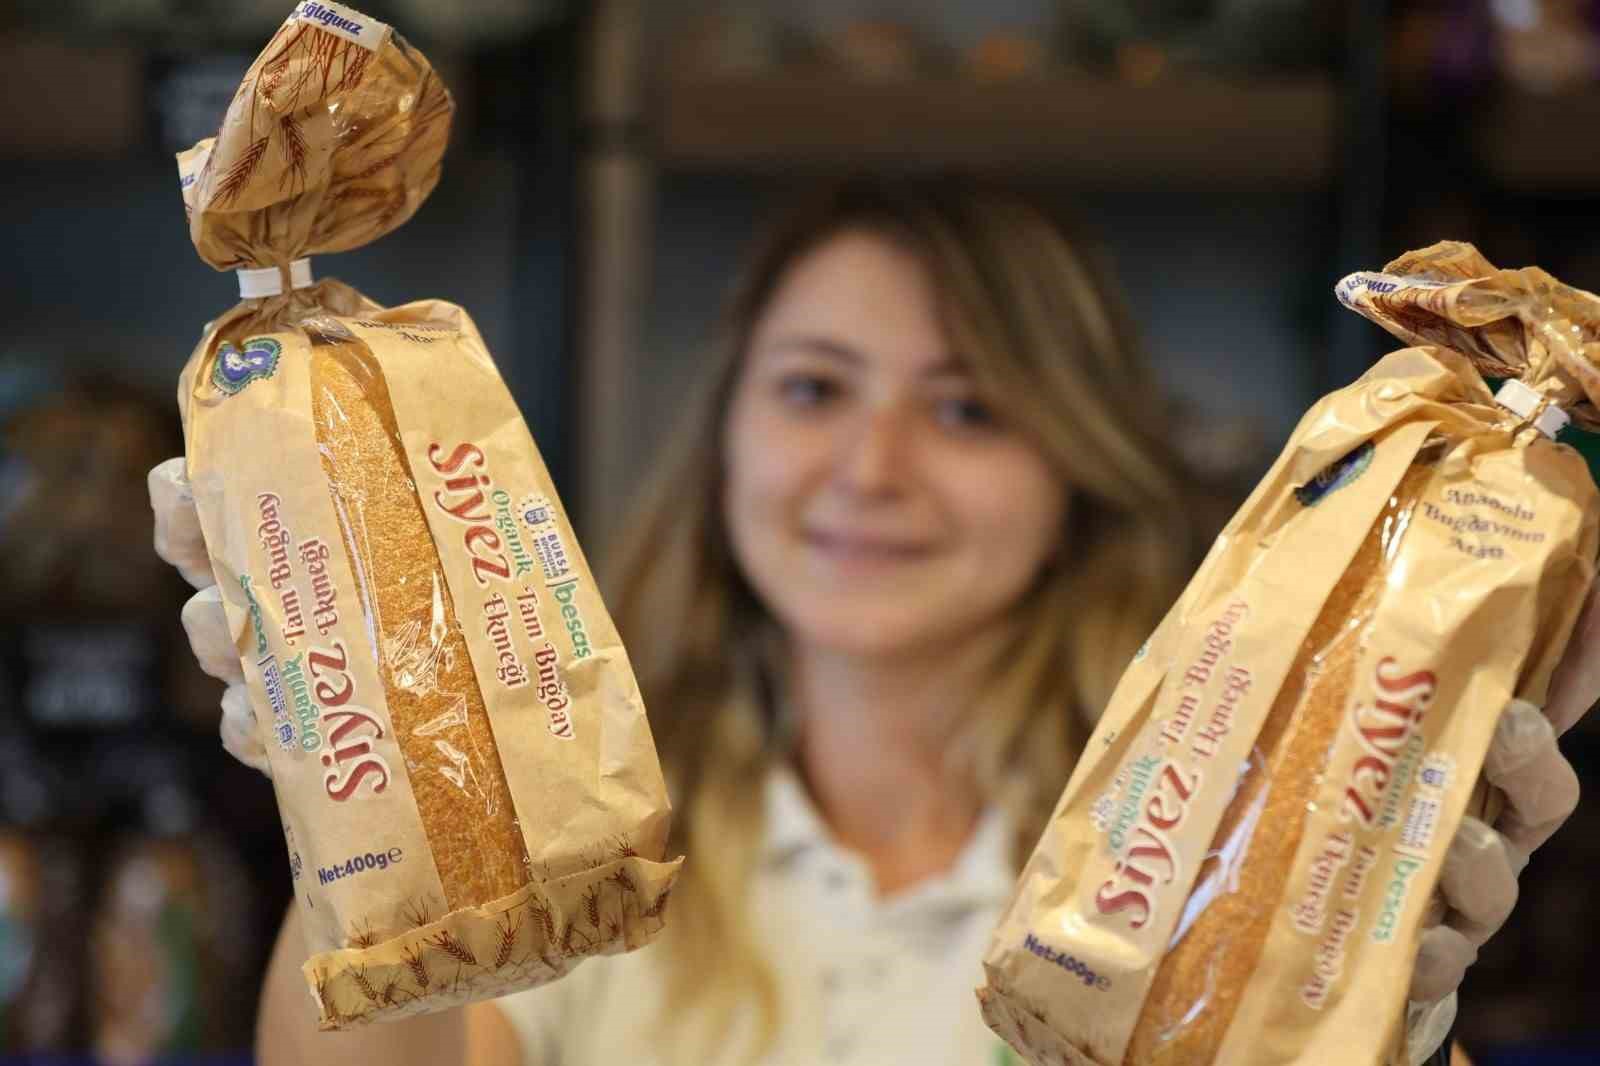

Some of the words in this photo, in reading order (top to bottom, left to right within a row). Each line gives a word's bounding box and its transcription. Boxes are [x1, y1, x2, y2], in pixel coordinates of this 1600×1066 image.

[257, 493, 291, 589] Buğday
[428, 443, 510, 583] Siyez
[492, 490, 534, 576] Organik
[547, 533, 569, 576] BURSA
[282, 589, 305, 646] Tam
[299, 539, 338, 636] Ekmeği
[554, 582, 592, 658] besaş
[484, 592, 527, 687] Ekmeği
[517, 585, 543, 638] Tam
[535, 643, 573, 738] Buğday
[282, 651, 321, 752] Organik
[309, 642, 388, 802] Siyez
[1341, 656, 1438, 823] Siyez
[1096, 764, 1198, 928] Siyez
